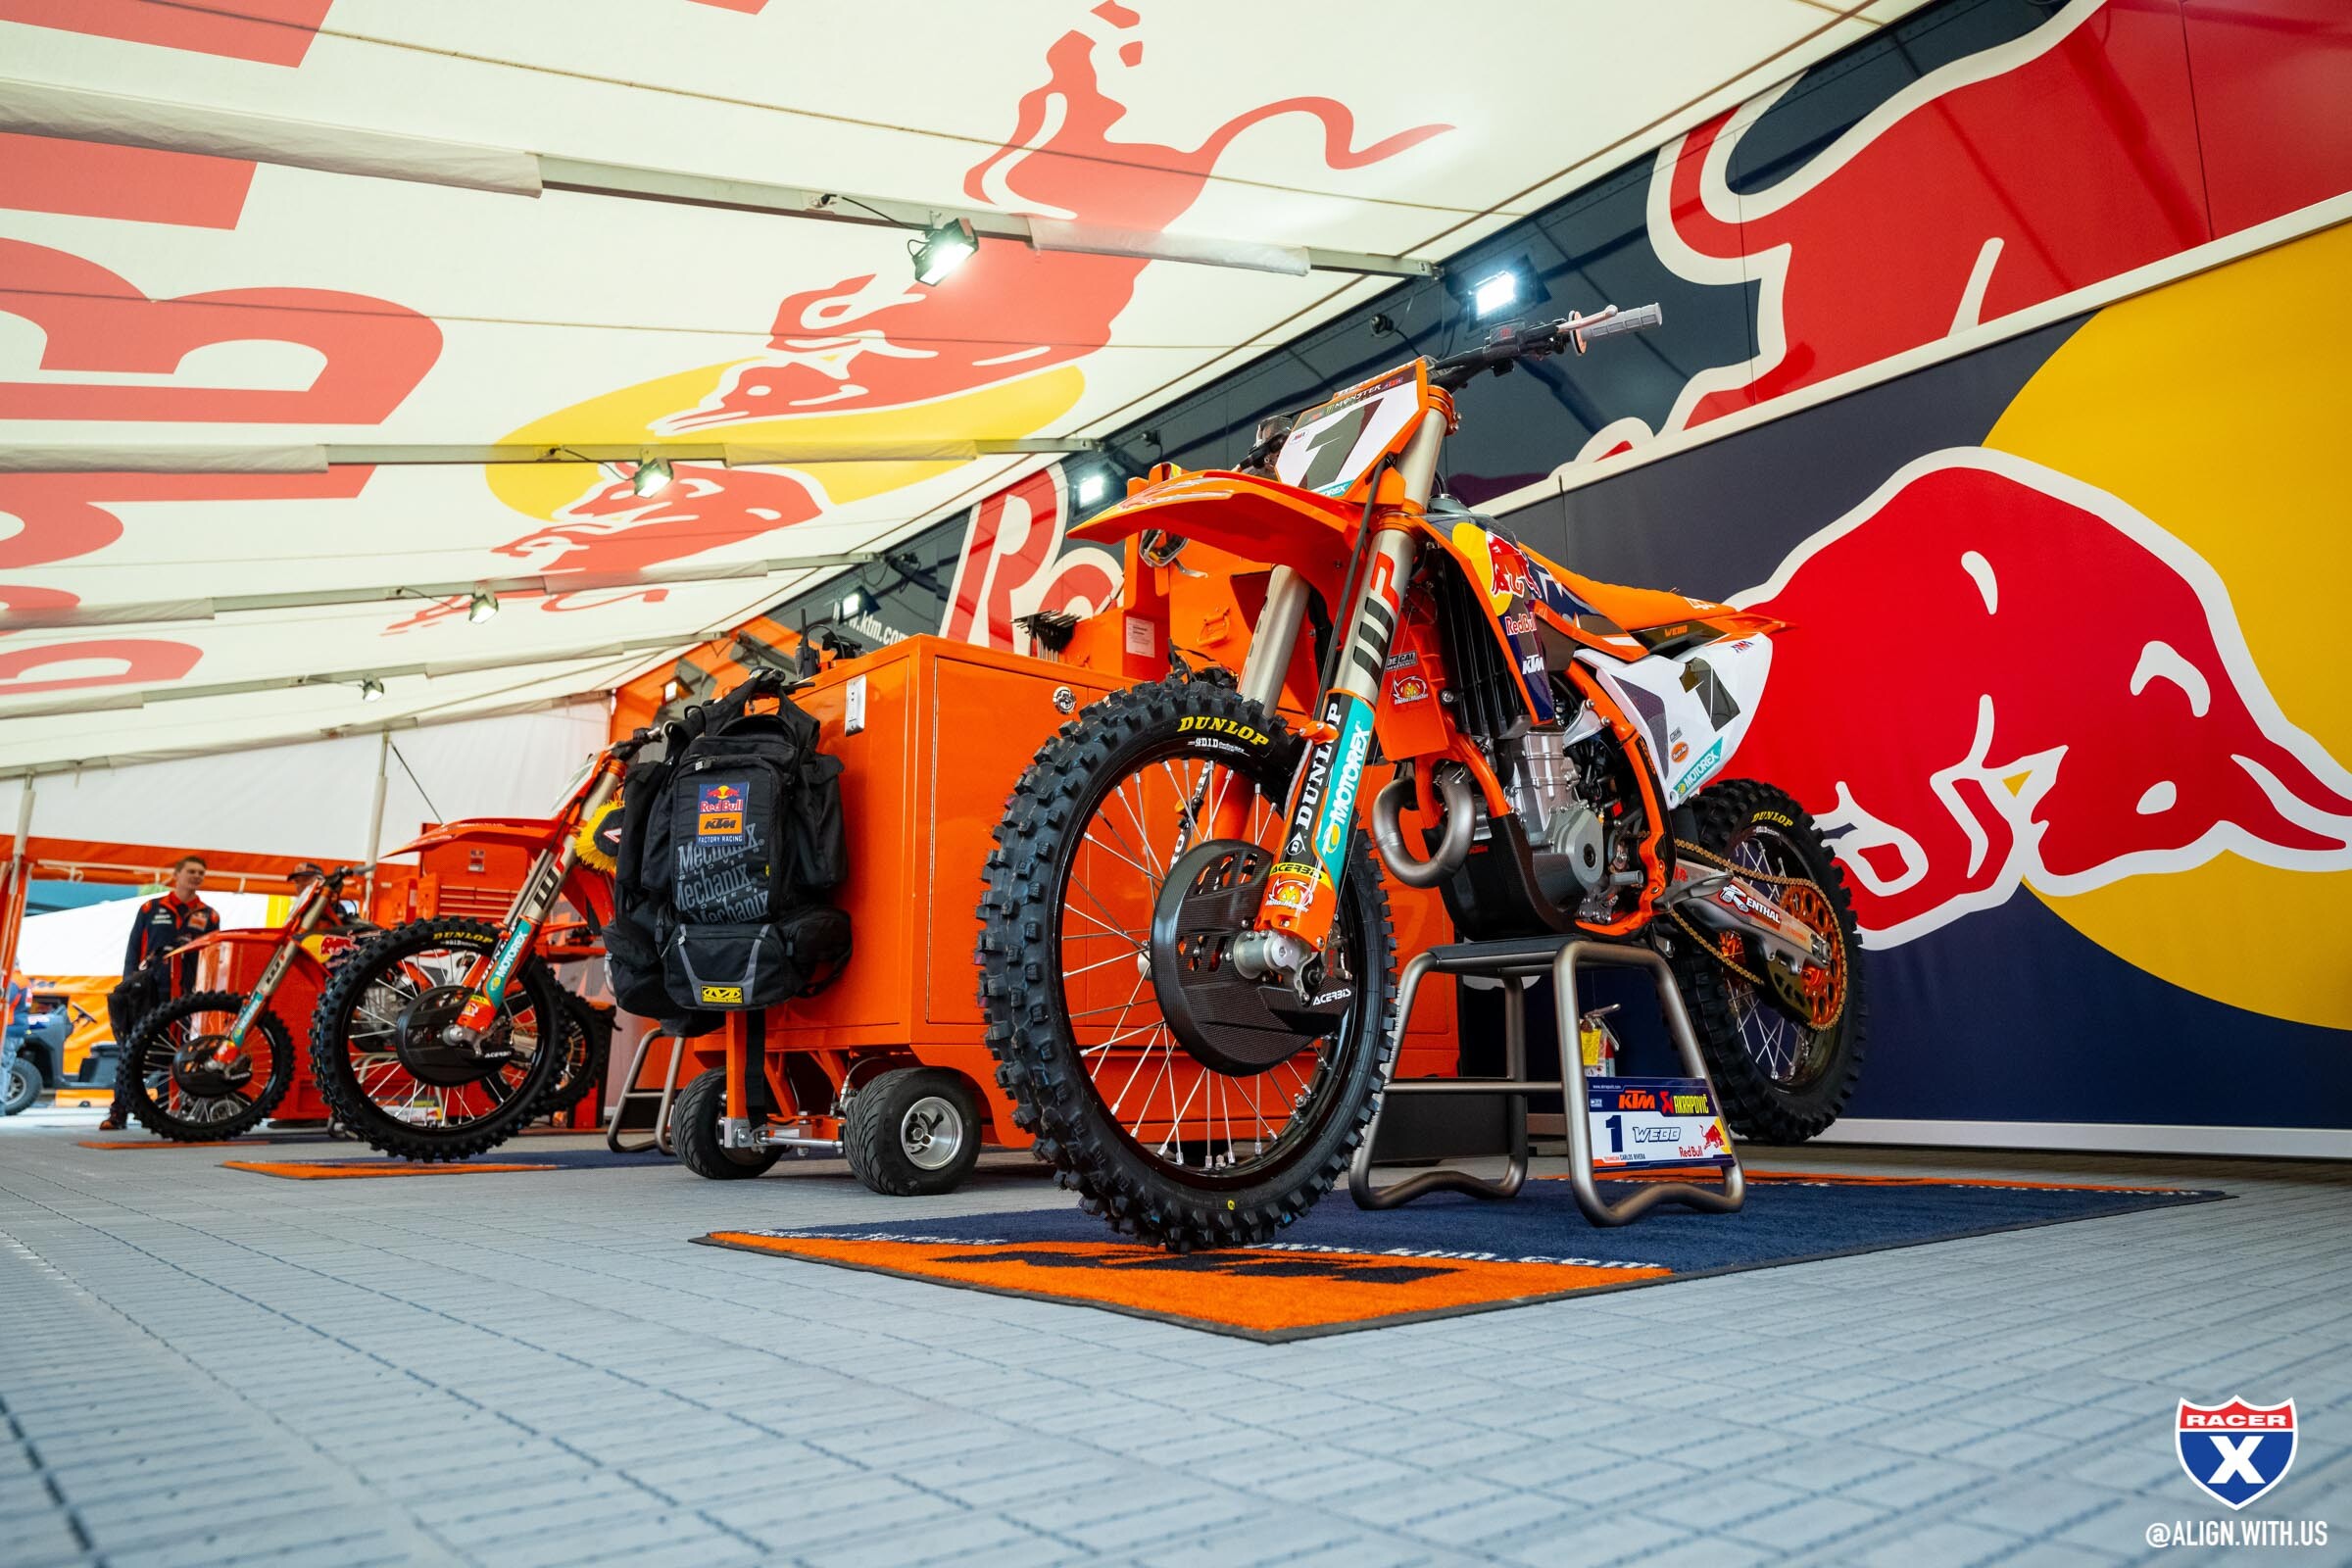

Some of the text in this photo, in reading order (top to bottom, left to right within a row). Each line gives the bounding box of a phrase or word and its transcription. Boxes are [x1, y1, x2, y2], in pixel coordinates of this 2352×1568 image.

[1333, 384, 1381, 409] MONSTER
[1298, 397, 1385, 491] 1
[1522, 654, 1544, 675] KTM
[1679, 657, 1740, 732] 1
[1177, 716, 1269, 745] DUNLOP
[1296, 703, 1343, 830] DUNLP
[1330, 724, 1371, 825] MOTOREX
[1685, 750, 1720, 787] MOTOREX
[700, 799, 743, 812] Red Bull
[704, 817, 737, 829] KTM
[1750, 810, 1794, 828] DUNLOP
[433, 932, 493, 943] DUNLOP
[496, 931, 529, 978] MOTOREX
[1313, 988, 1351, 1005] ACERBIS
[1618, 1090, 1655, 1109] KTM
[1605, 1115, 1681, 1152] 1 WEBB
[1679, 1146, 1703, 1157] Red Bull
